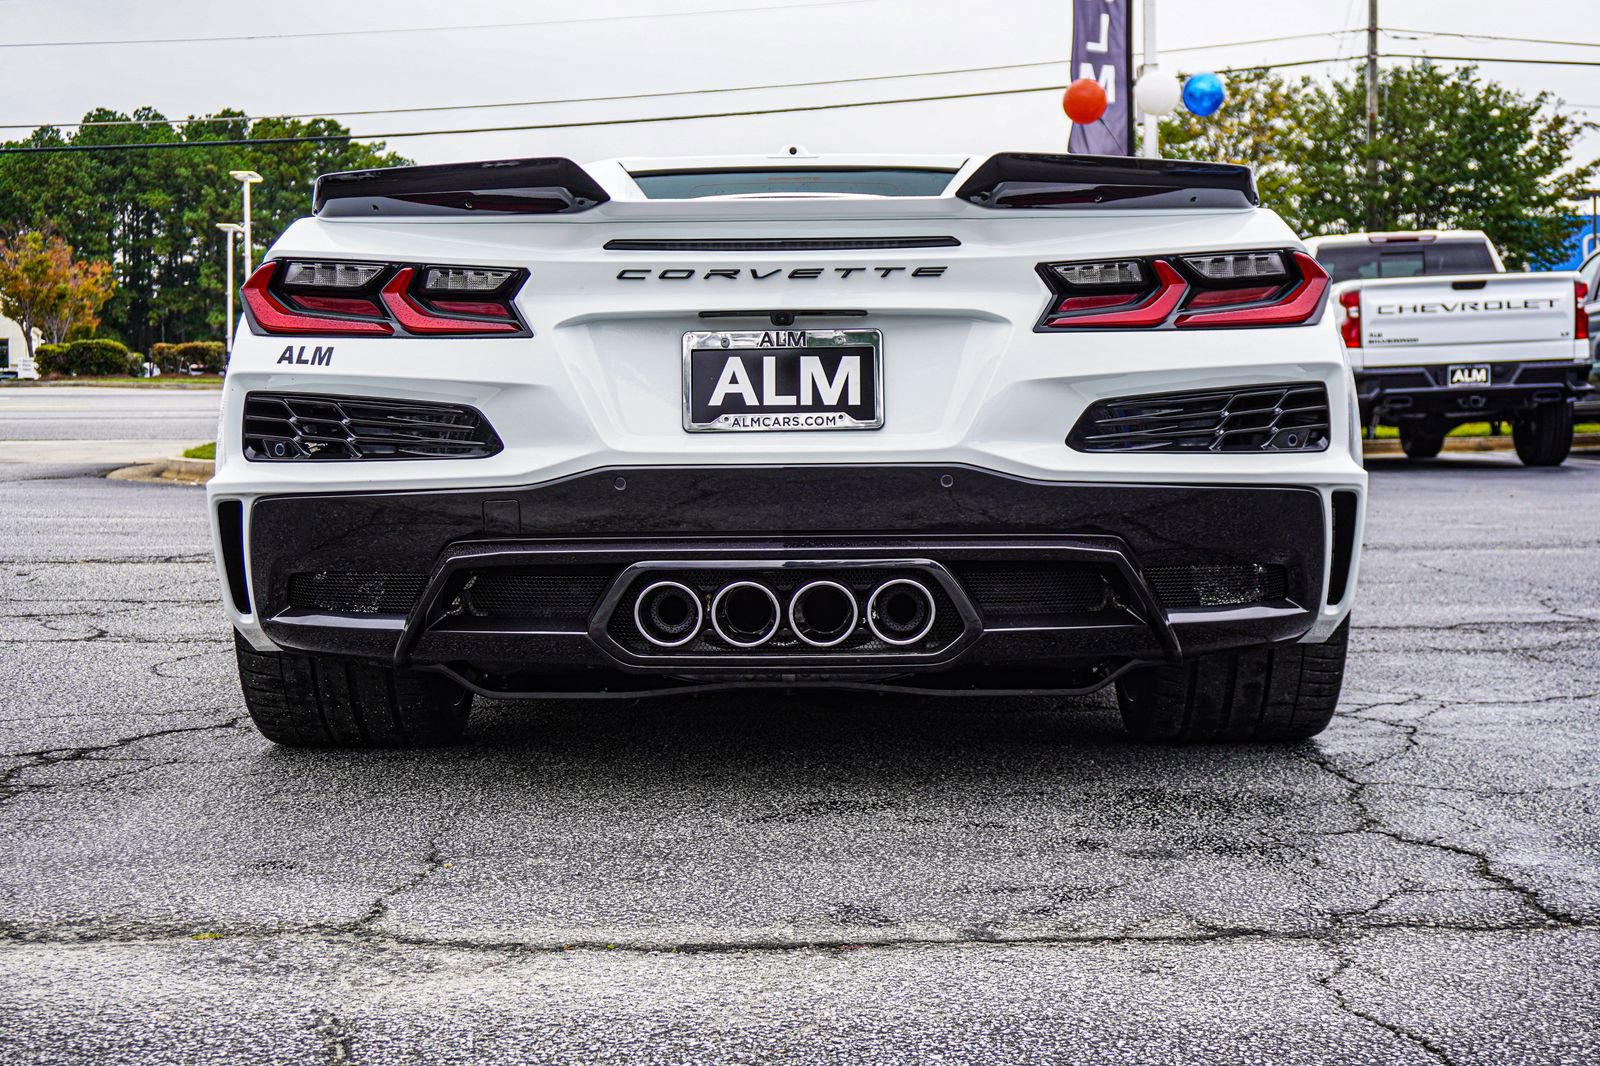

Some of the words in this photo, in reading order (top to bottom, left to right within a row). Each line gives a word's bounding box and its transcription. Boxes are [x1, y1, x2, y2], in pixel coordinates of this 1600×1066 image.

[616, 266, 949, 281] CORVETTE
[1377, 299, 1558, 315] CHEVROLET
[759, 331, 807, 348] ALM
[277, 345, 335, 367] ALM
[708, 355, 861, 406] ALM
[1452, 368, 1487, 383] ALM
[731, 415, 837, 429] ALMCARS.COM
